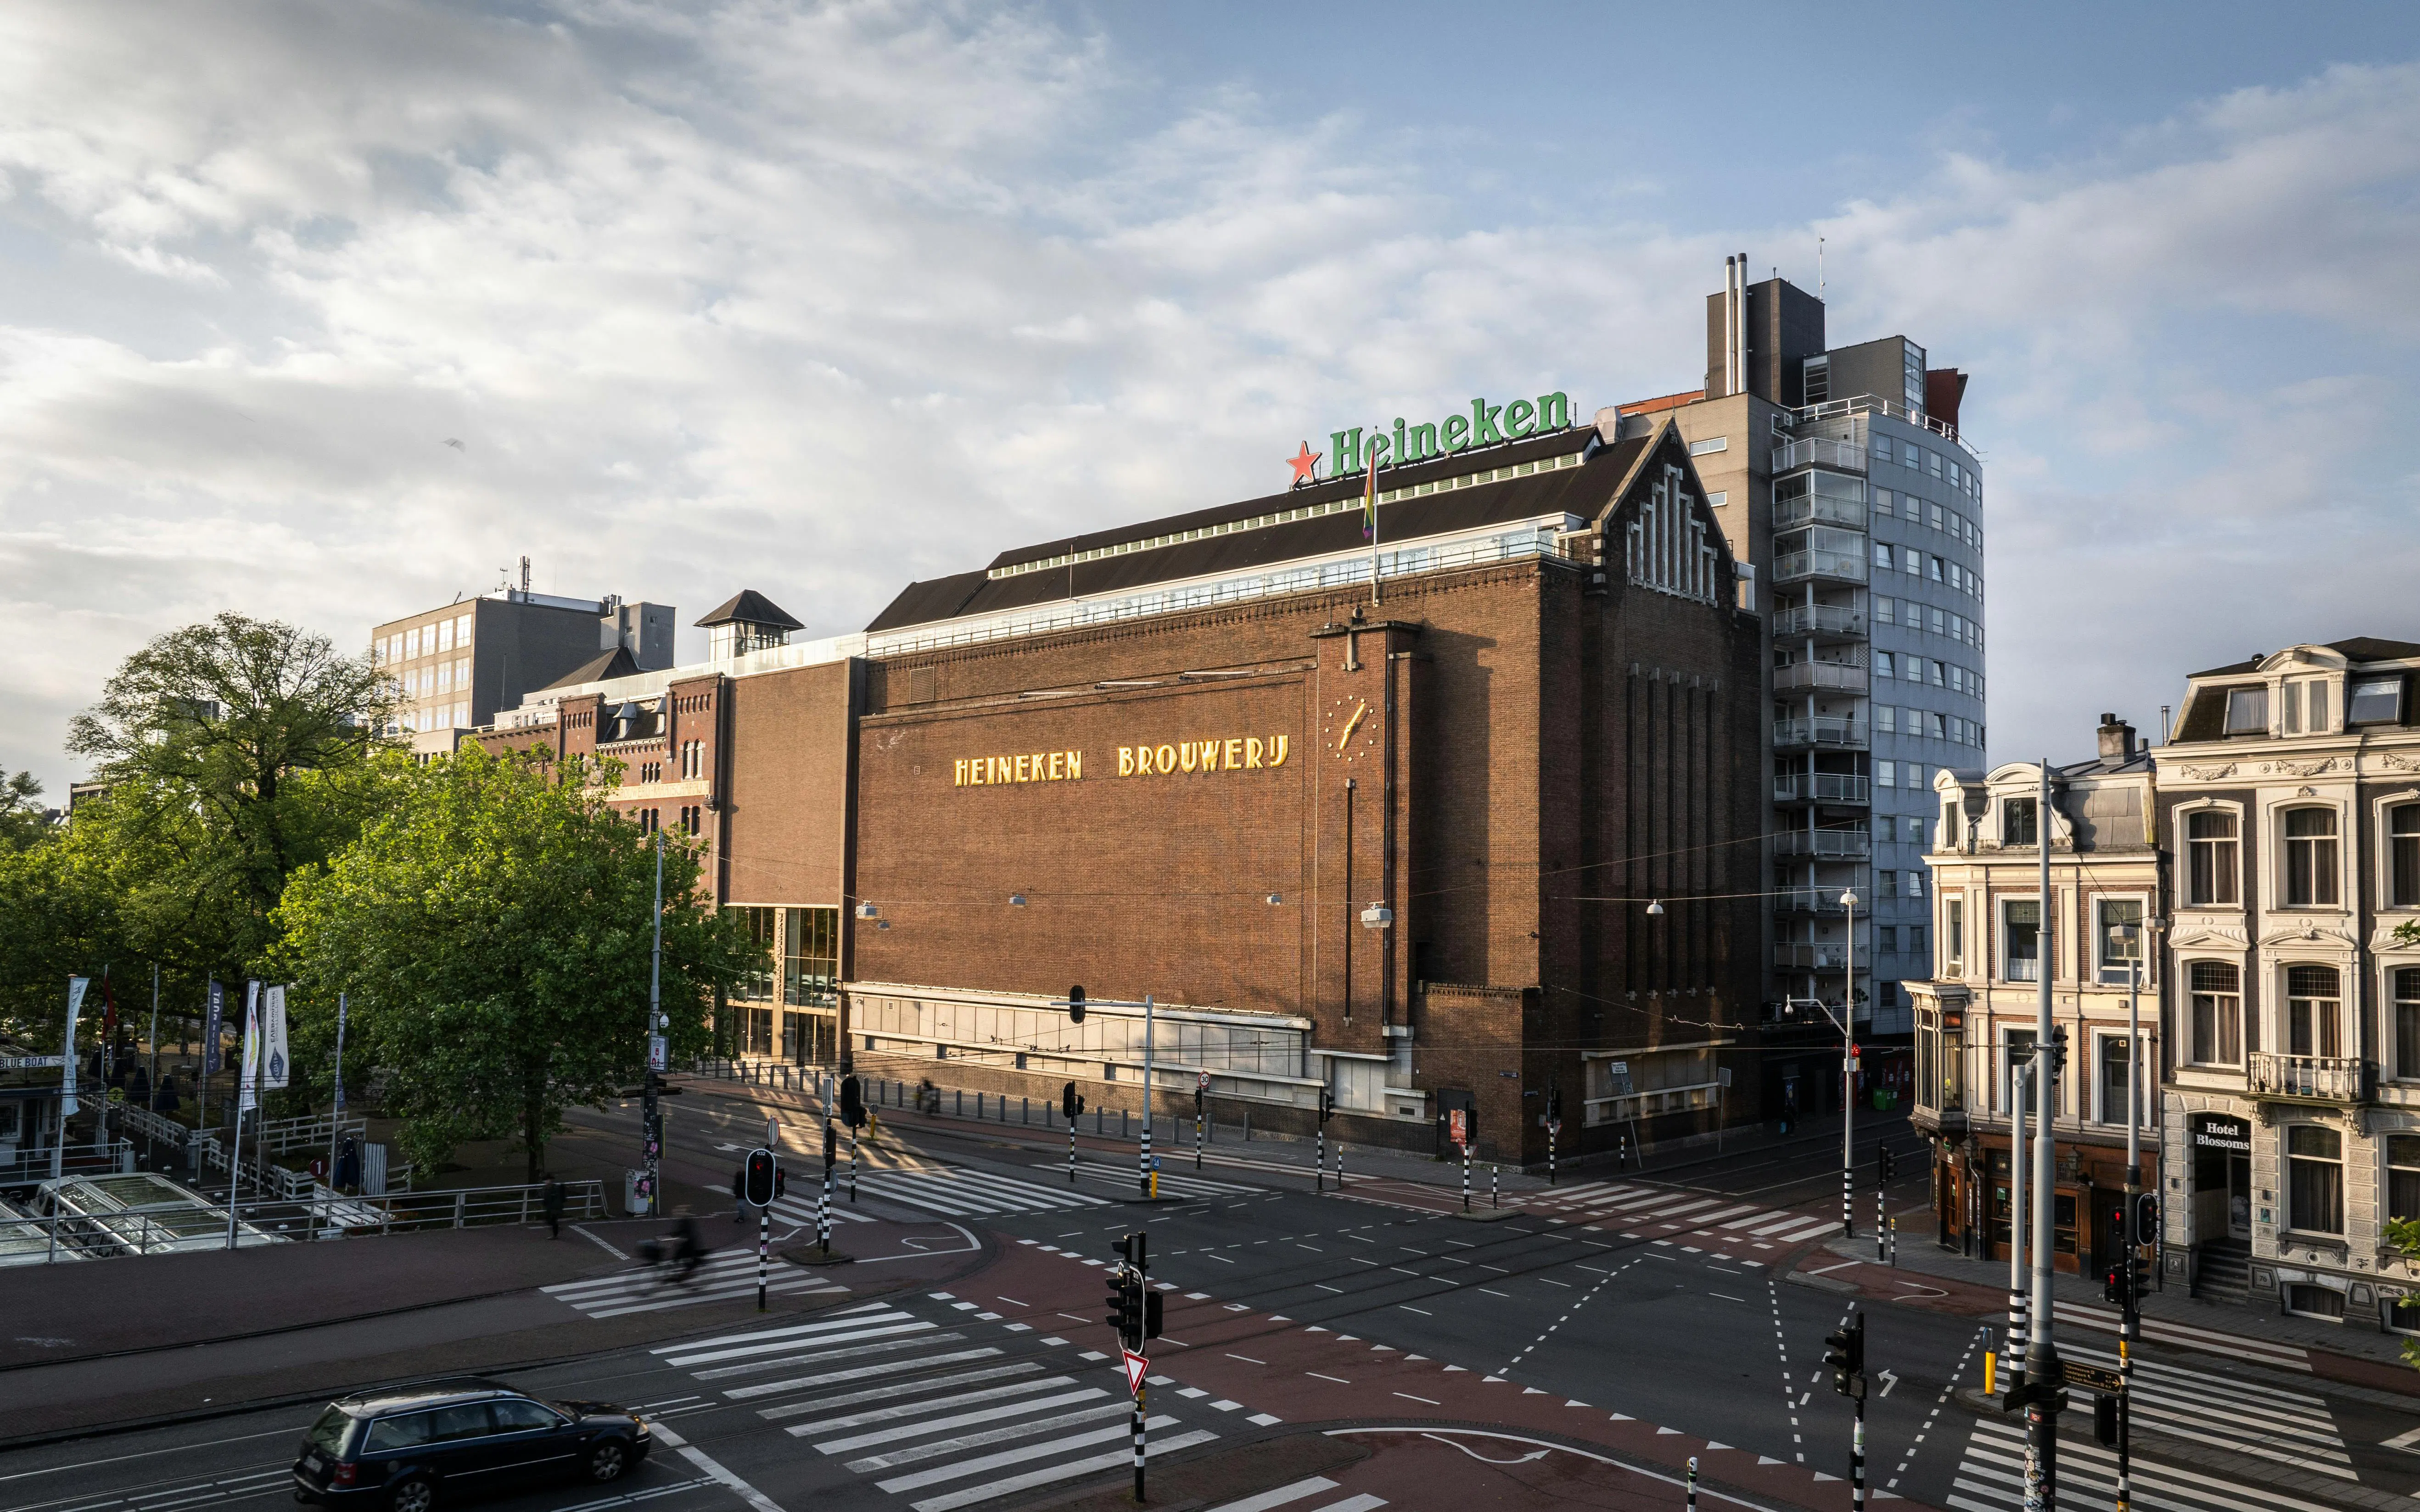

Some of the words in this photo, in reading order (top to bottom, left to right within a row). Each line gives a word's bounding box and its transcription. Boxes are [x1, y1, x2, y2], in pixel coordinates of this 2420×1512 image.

[1330, 391, 1571, 477] Heineken
[955, 751, 1082, 787] HEINEKEN
[1119, 735, 1288, 776] BROUWERIJ
[0, 1058, 22, 1068] BLUE
[25, 1057, 48, 1066] BOAT
[114, 1090, 119, 1099] 2
[2206, 1122, 2239, 1136] Hotel
[2196, 1134, 2250, 1150] Blossoms
[317, 1161, 321, 1174] 1
